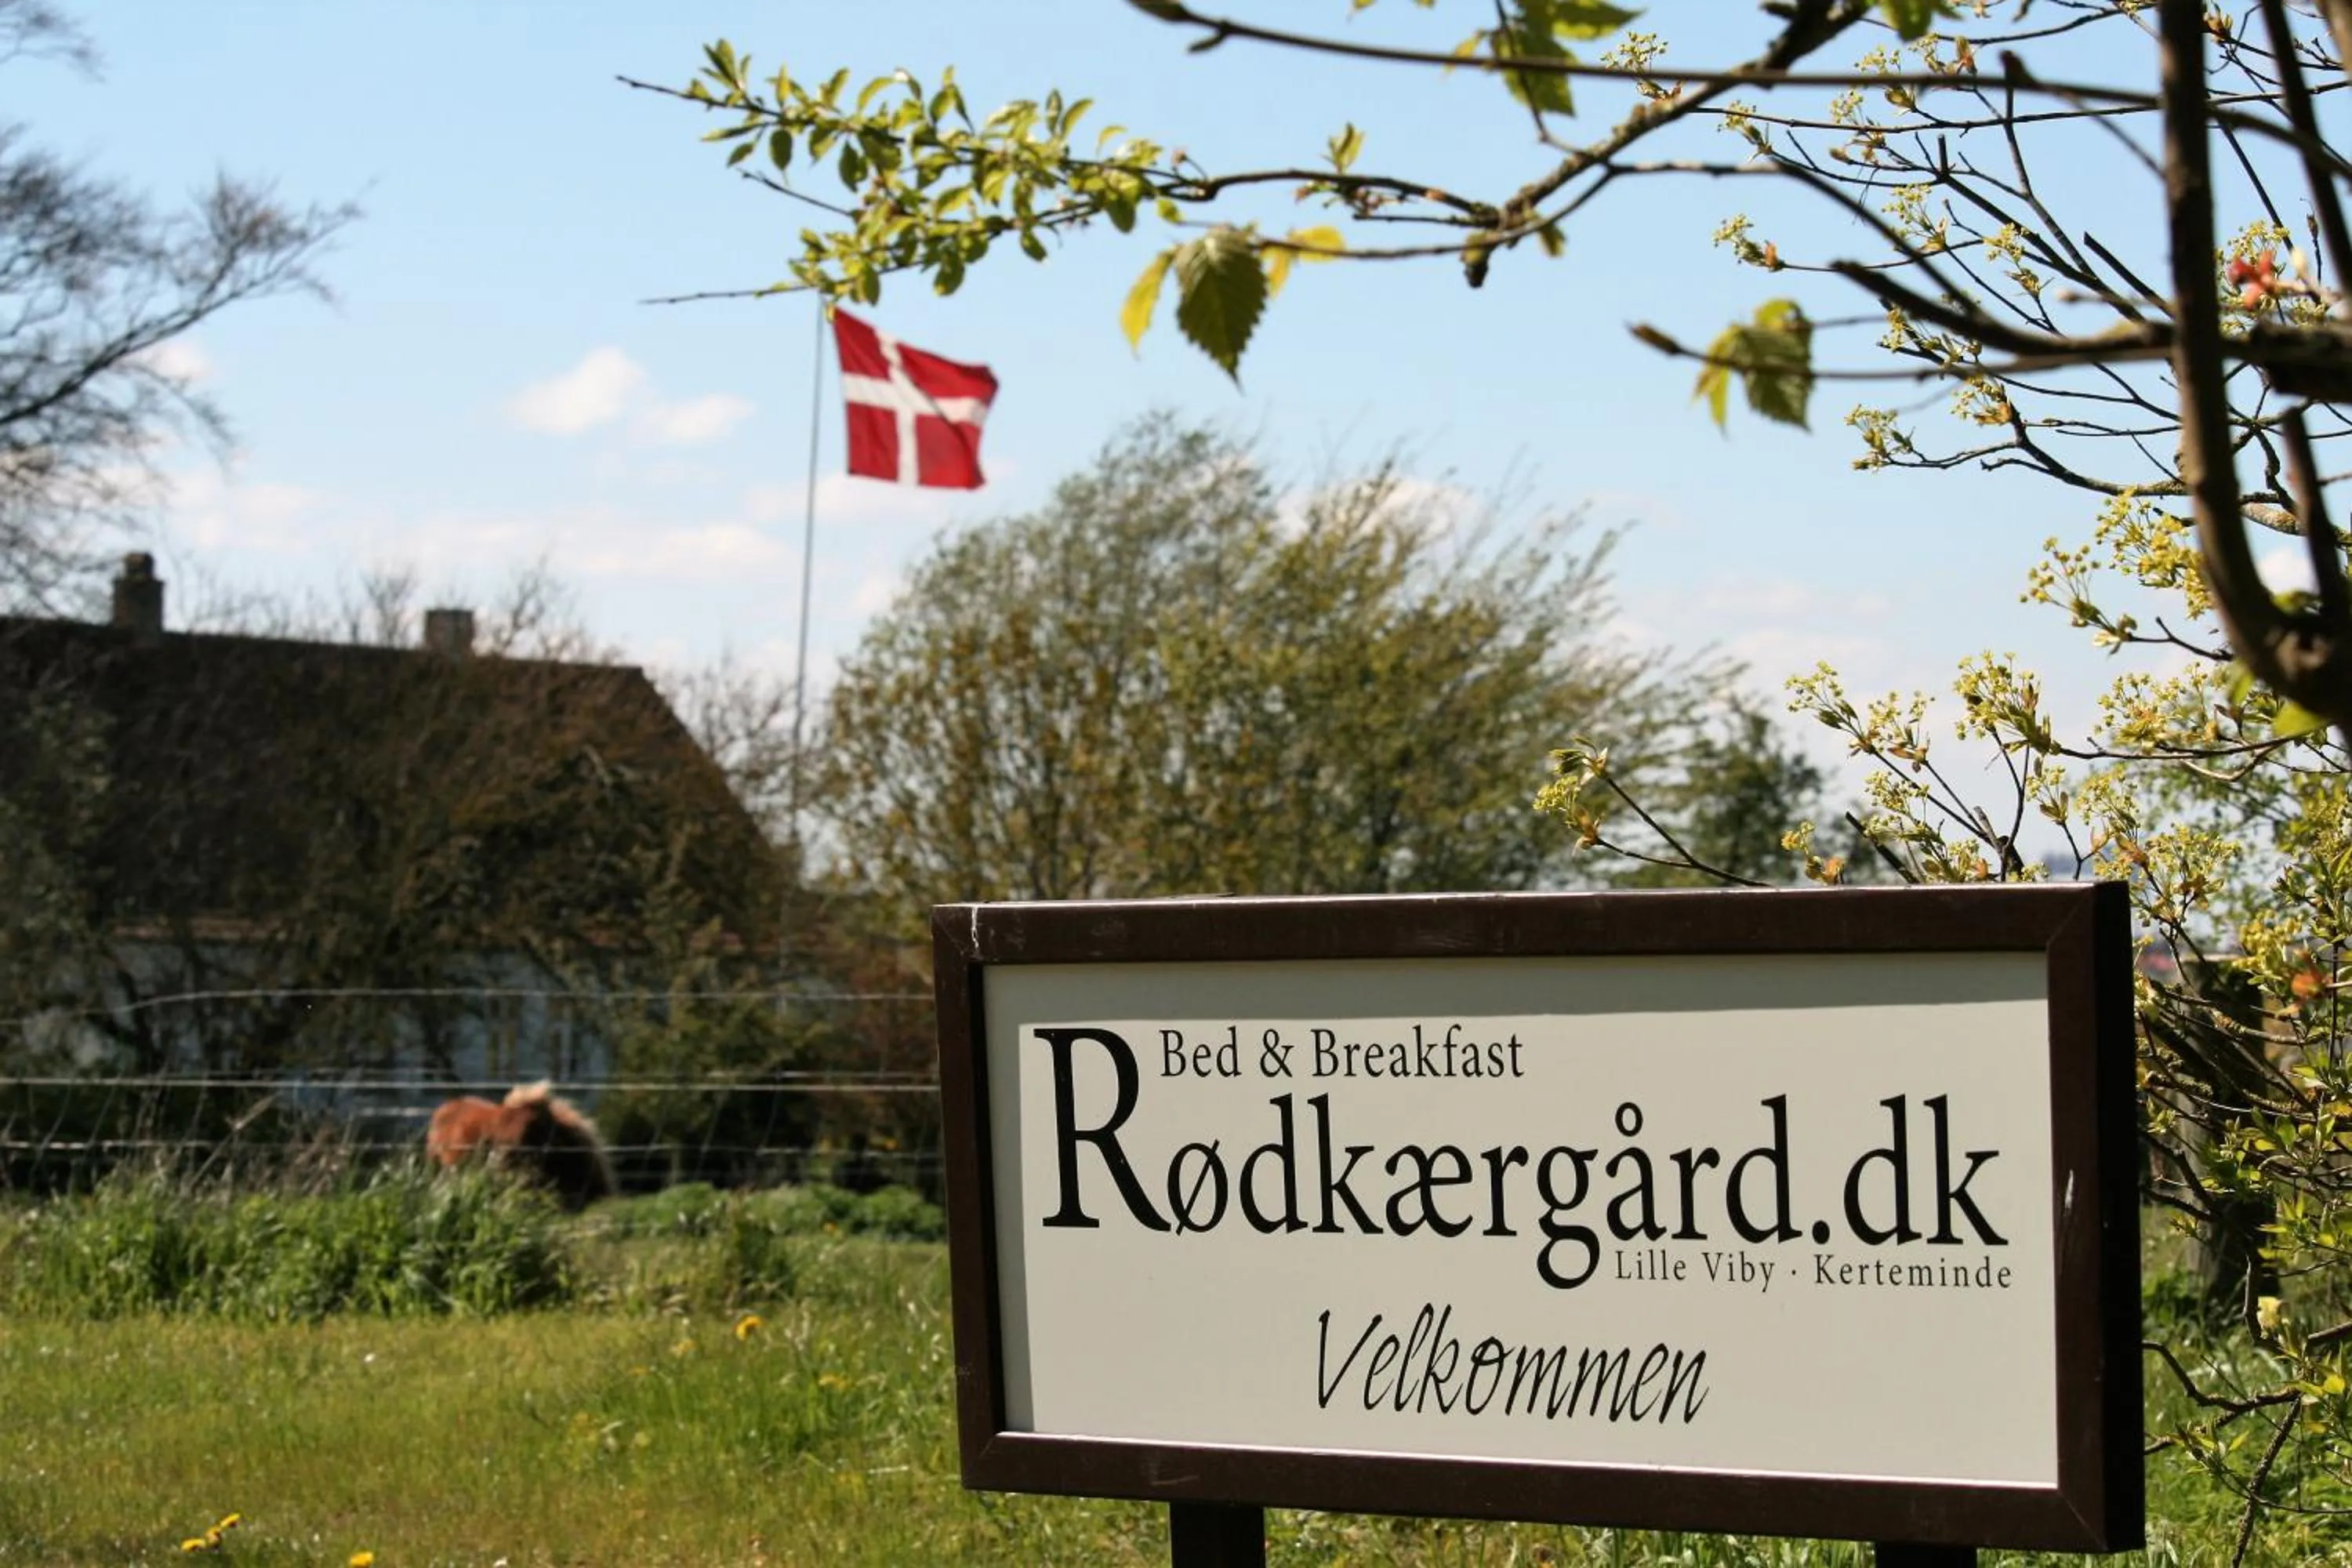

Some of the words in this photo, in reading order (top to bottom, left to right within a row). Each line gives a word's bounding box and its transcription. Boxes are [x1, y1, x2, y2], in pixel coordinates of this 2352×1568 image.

[1158, 1025, 1243, 1078] Bed
[1259, 1028, 1294, 1078] &
[1310, 1024, 1525, 1078] Breakfast
[1033, 1028, 2009, 1290] Rødkærgård.dk
[1615, 1249, 1686, 1281] Lille
[1701, 1250, 1775, 1293] Viby
[1813, 1254, 2012, 1289] Kerteminde
[1318, 1302, 1709, 1425] Velkommen
